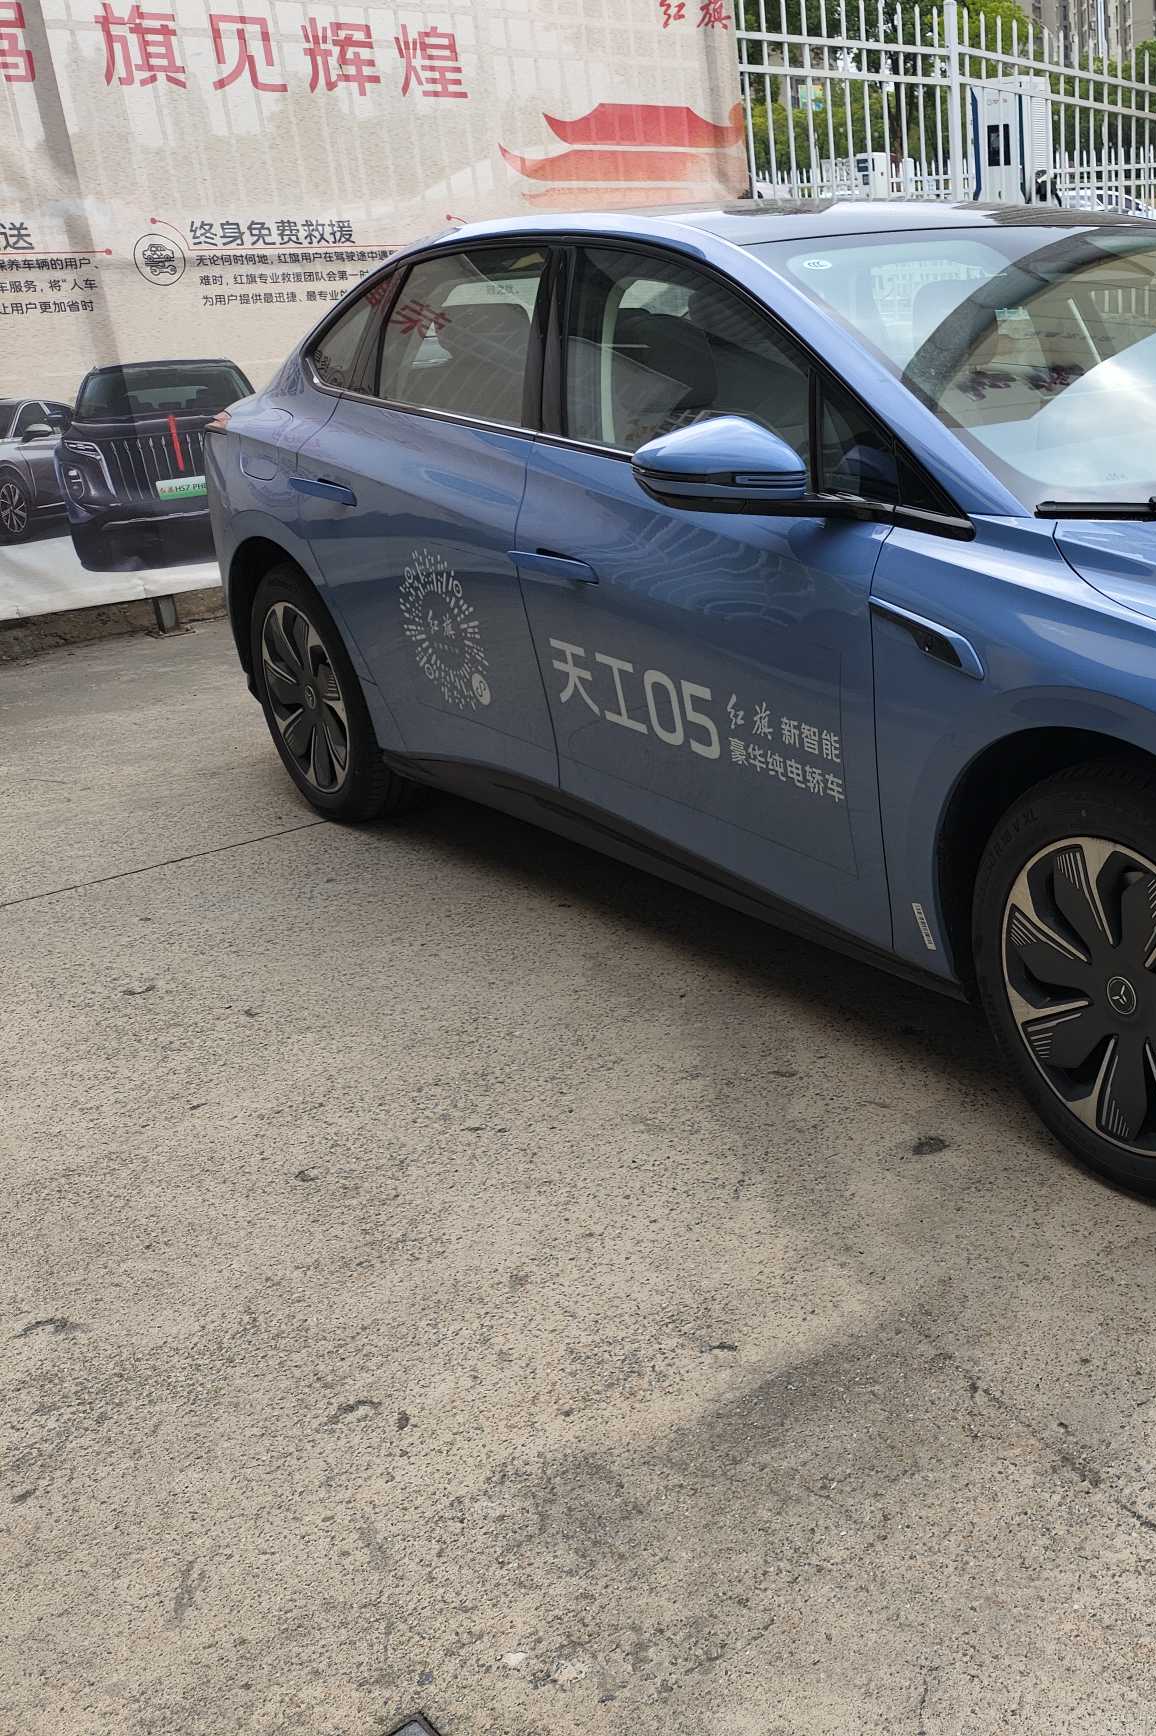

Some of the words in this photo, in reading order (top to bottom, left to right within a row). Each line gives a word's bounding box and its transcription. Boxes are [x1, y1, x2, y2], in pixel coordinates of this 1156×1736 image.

[659, 0, 732, 30] 红旗
[94, 3, 470, 99] 旗见辉煌
[189, 219, 356, 247] 终身免费救援
[195, 250, 399, 267] 无论何时何地，红旗用户在驾驶途中遇
[192, 482, 208, 491] PHE
[549, 637, 721, 760] 天工05
[727, 693, 774, 741] 红旗
[781, 716, 841, 763] 新智能
[729, 737, 845, 802] 豪华纯电轿车
